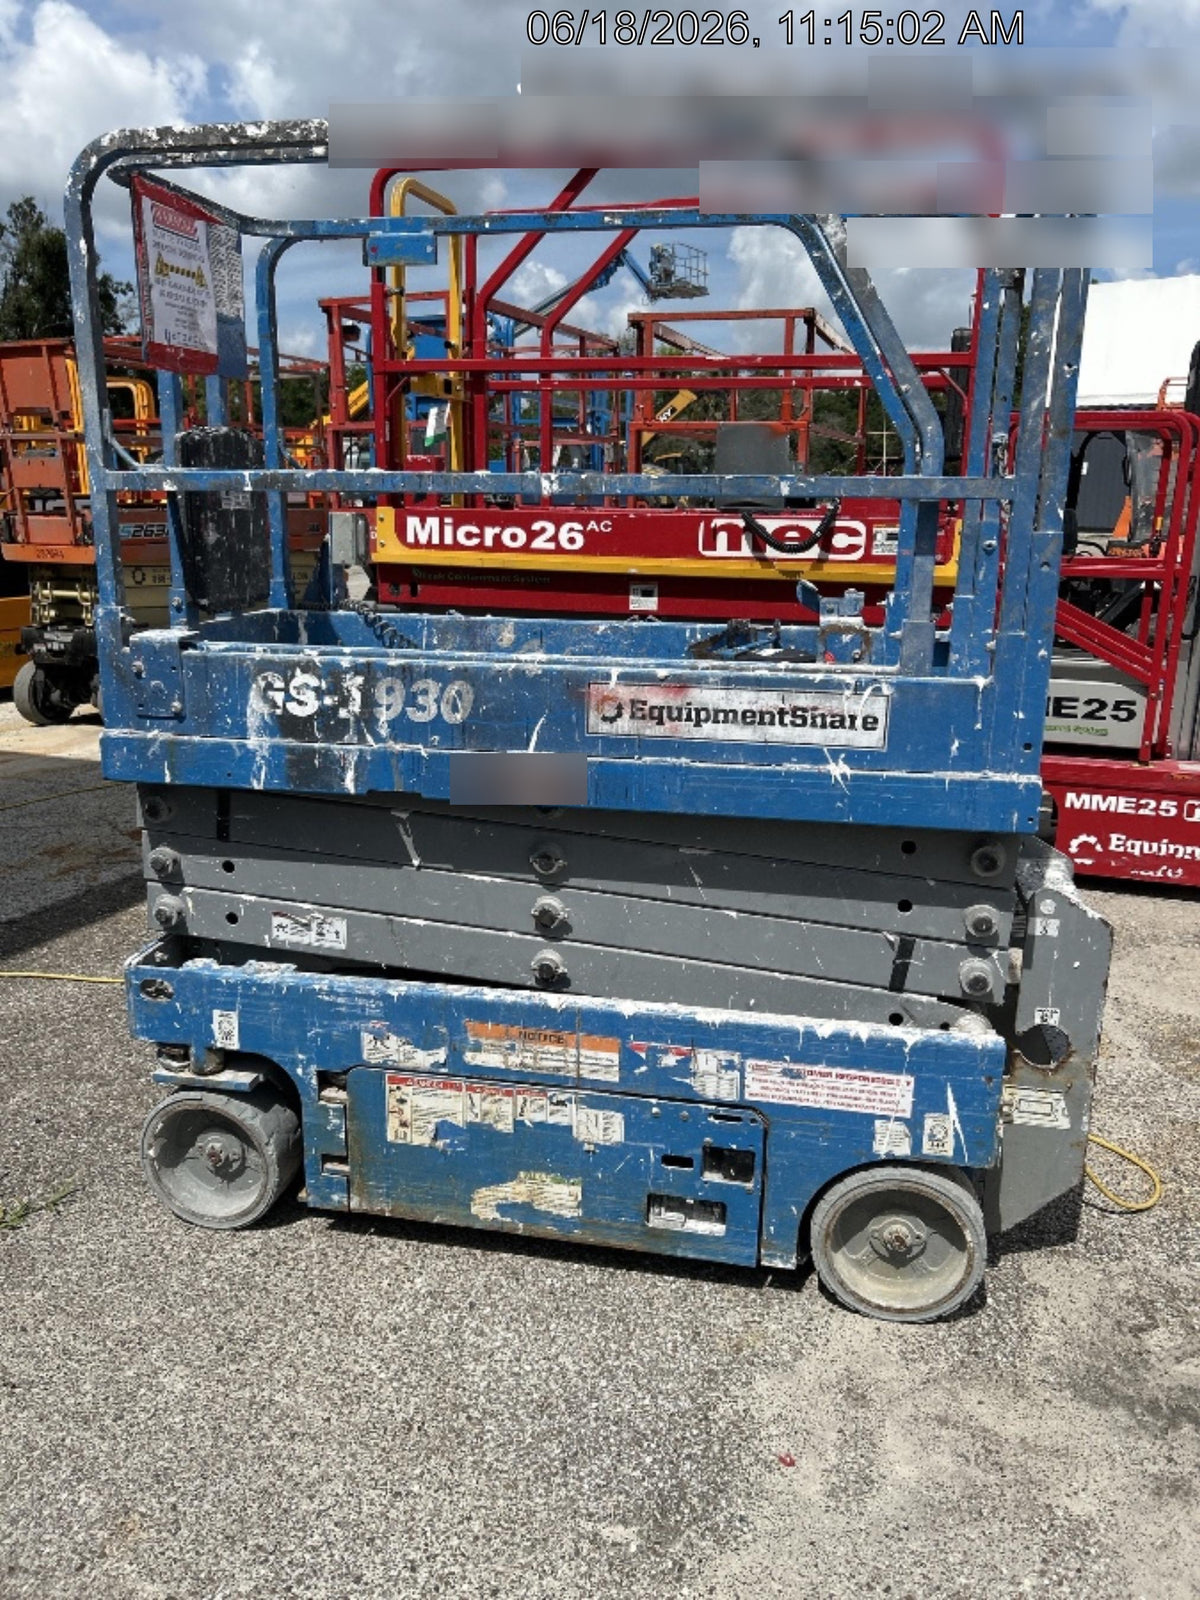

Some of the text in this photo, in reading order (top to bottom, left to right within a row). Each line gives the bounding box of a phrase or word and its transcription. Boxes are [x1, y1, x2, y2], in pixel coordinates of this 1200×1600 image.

[406, 515, 585, 551] Micro26
[700, 520, 864, 556] mec
[251, 670, 475, 724] GS-1930
[1045, 696, 1137, 722] E25
[1065, 792, 1178, 817] MME25
